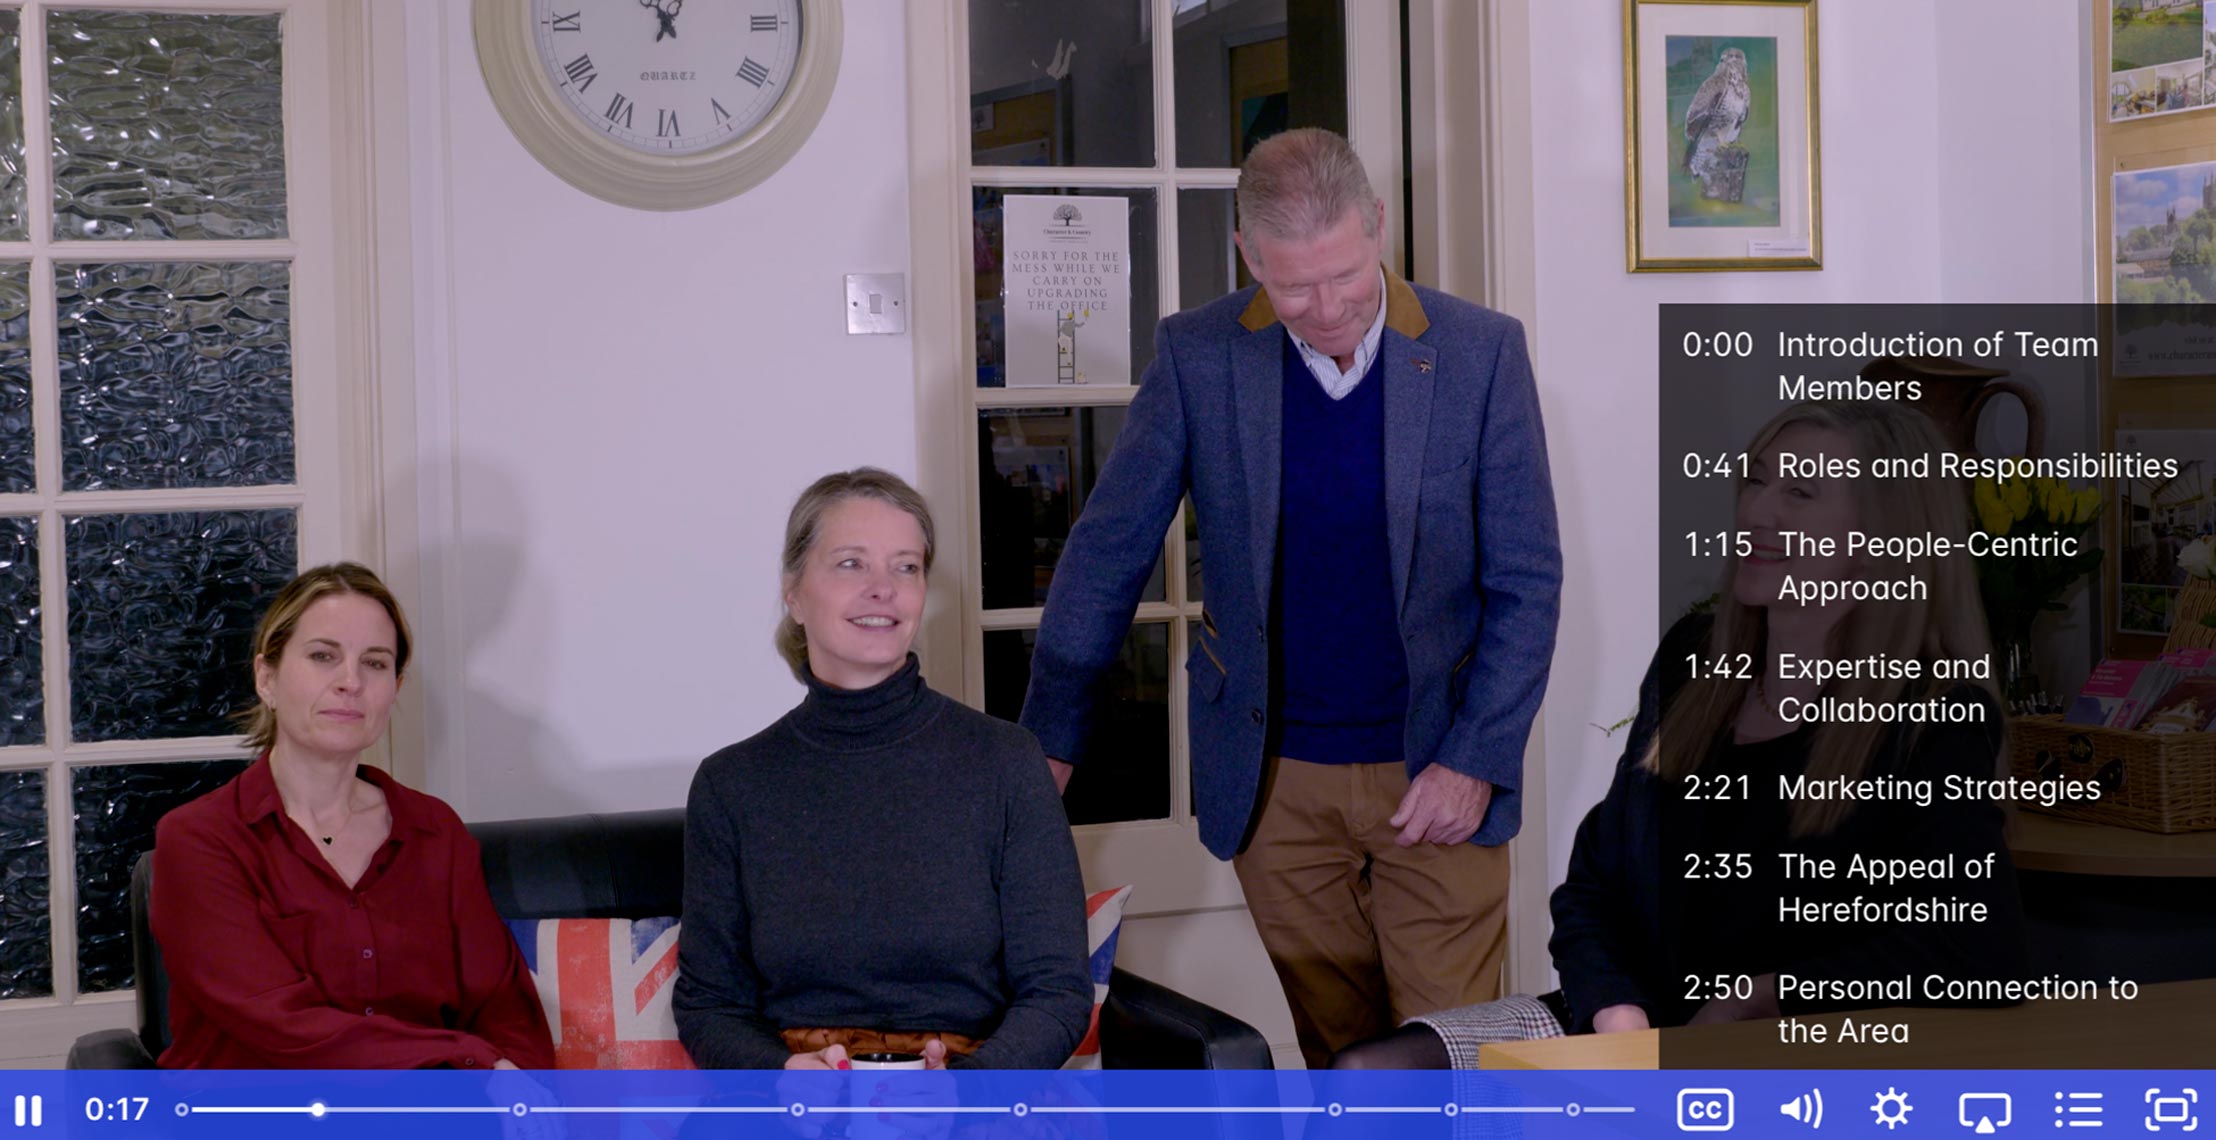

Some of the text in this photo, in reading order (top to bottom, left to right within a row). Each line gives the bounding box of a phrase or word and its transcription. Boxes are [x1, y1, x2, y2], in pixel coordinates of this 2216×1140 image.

[750, 14, 778, 32] III
[640, 71, 696, 81] QUARTZ
[1013, 250, 1119, 261] SORRY FOR THE
[1012, 263, 1120, 273] MESS WHILE WE
[1032, 276, 1102, 286] CARRY ON
[1027, 288, 1108, 298] UPGRADING
[1027, 301, 1108, 311] THE OFFICE
